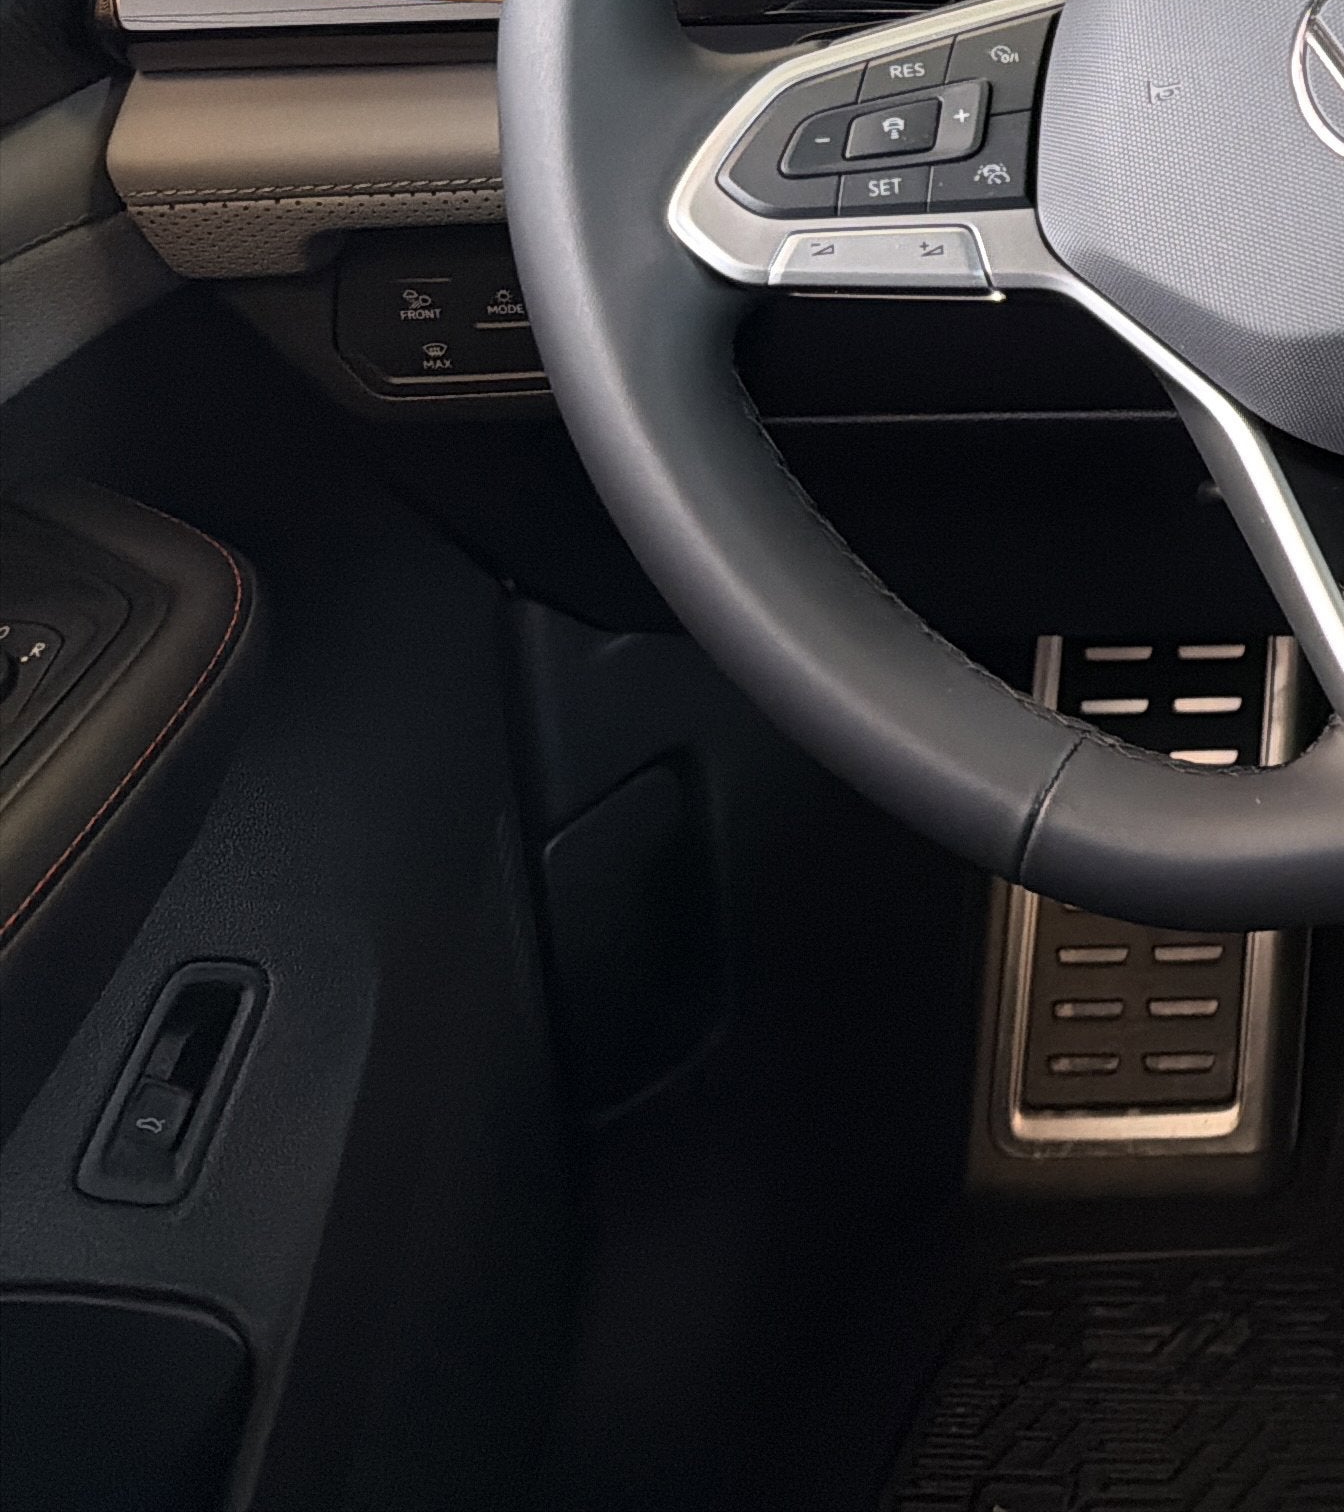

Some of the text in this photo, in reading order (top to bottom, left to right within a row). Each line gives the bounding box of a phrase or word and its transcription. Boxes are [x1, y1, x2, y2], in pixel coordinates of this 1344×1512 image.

[889, 62, 926, 79] RES
[868, 178, 903, 197] SET
[400, 308, 442, 320] FRONT
[487, 304, 524, 315] MODE
[423, 359, 452, 370] MAX
